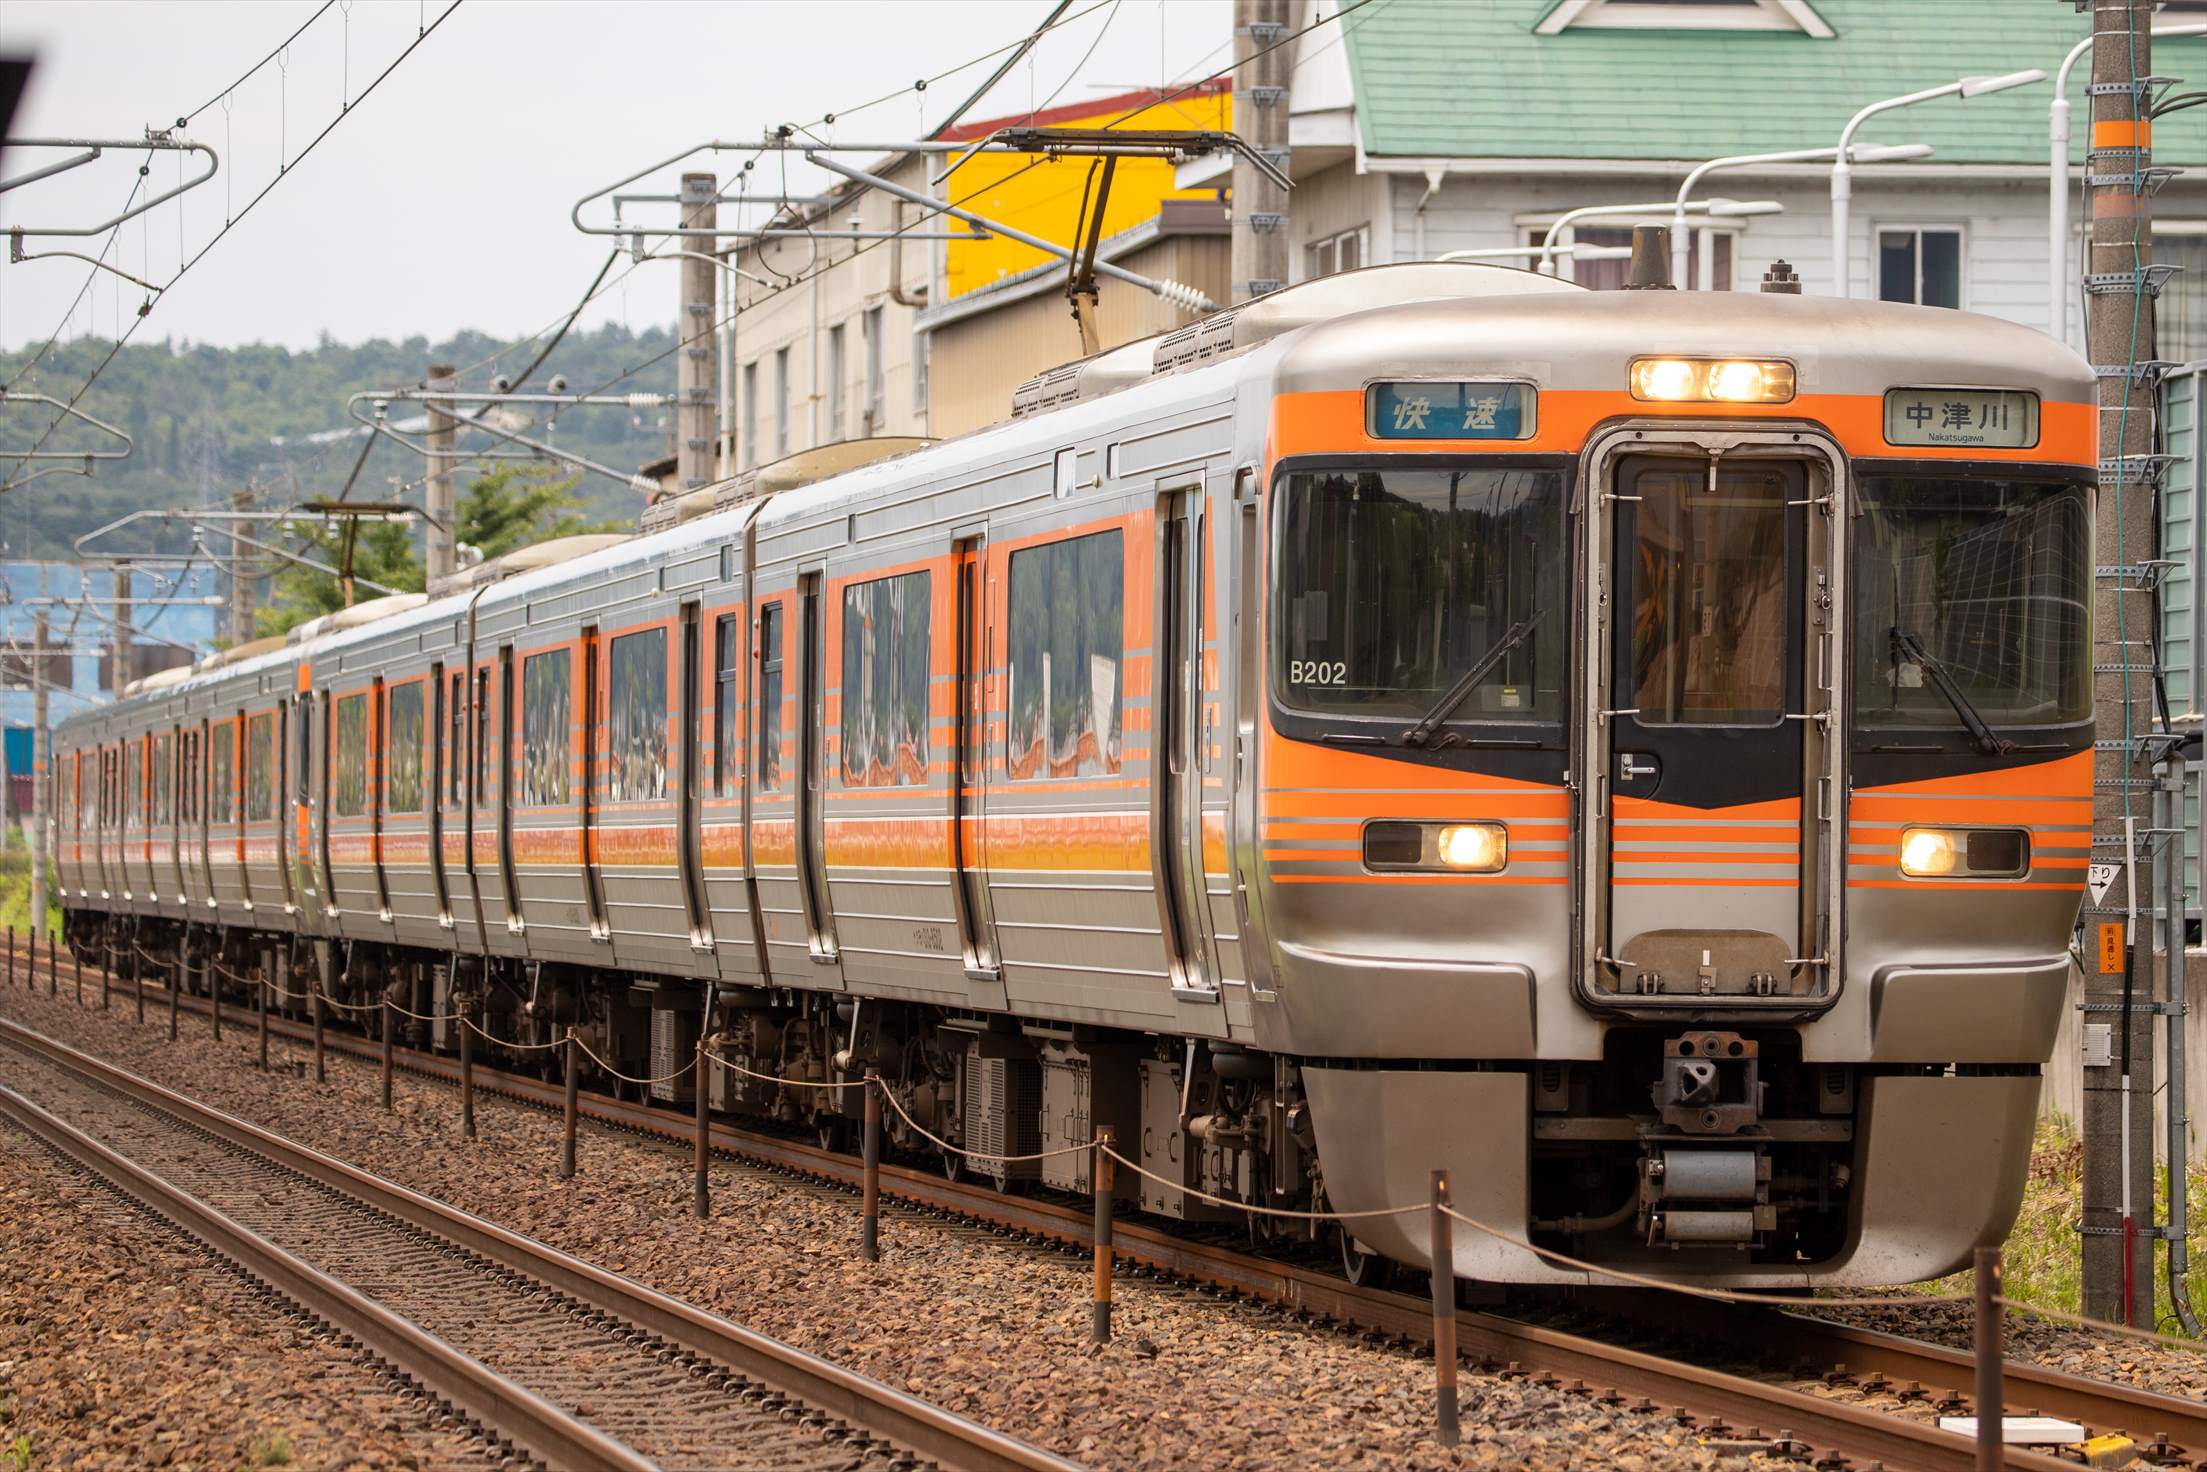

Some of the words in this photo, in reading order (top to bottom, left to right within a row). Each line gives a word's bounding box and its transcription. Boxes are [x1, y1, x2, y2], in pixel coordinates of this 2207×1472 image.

[1393, 396, 1501, 430] 快速
[1906, 402, 2008, 430] 中津川
[1928, 433, 1984, 444] Nakatsugawa
[1290, 661, 1346, 685] B202
[2090, 866, 2110, 879] 下り
